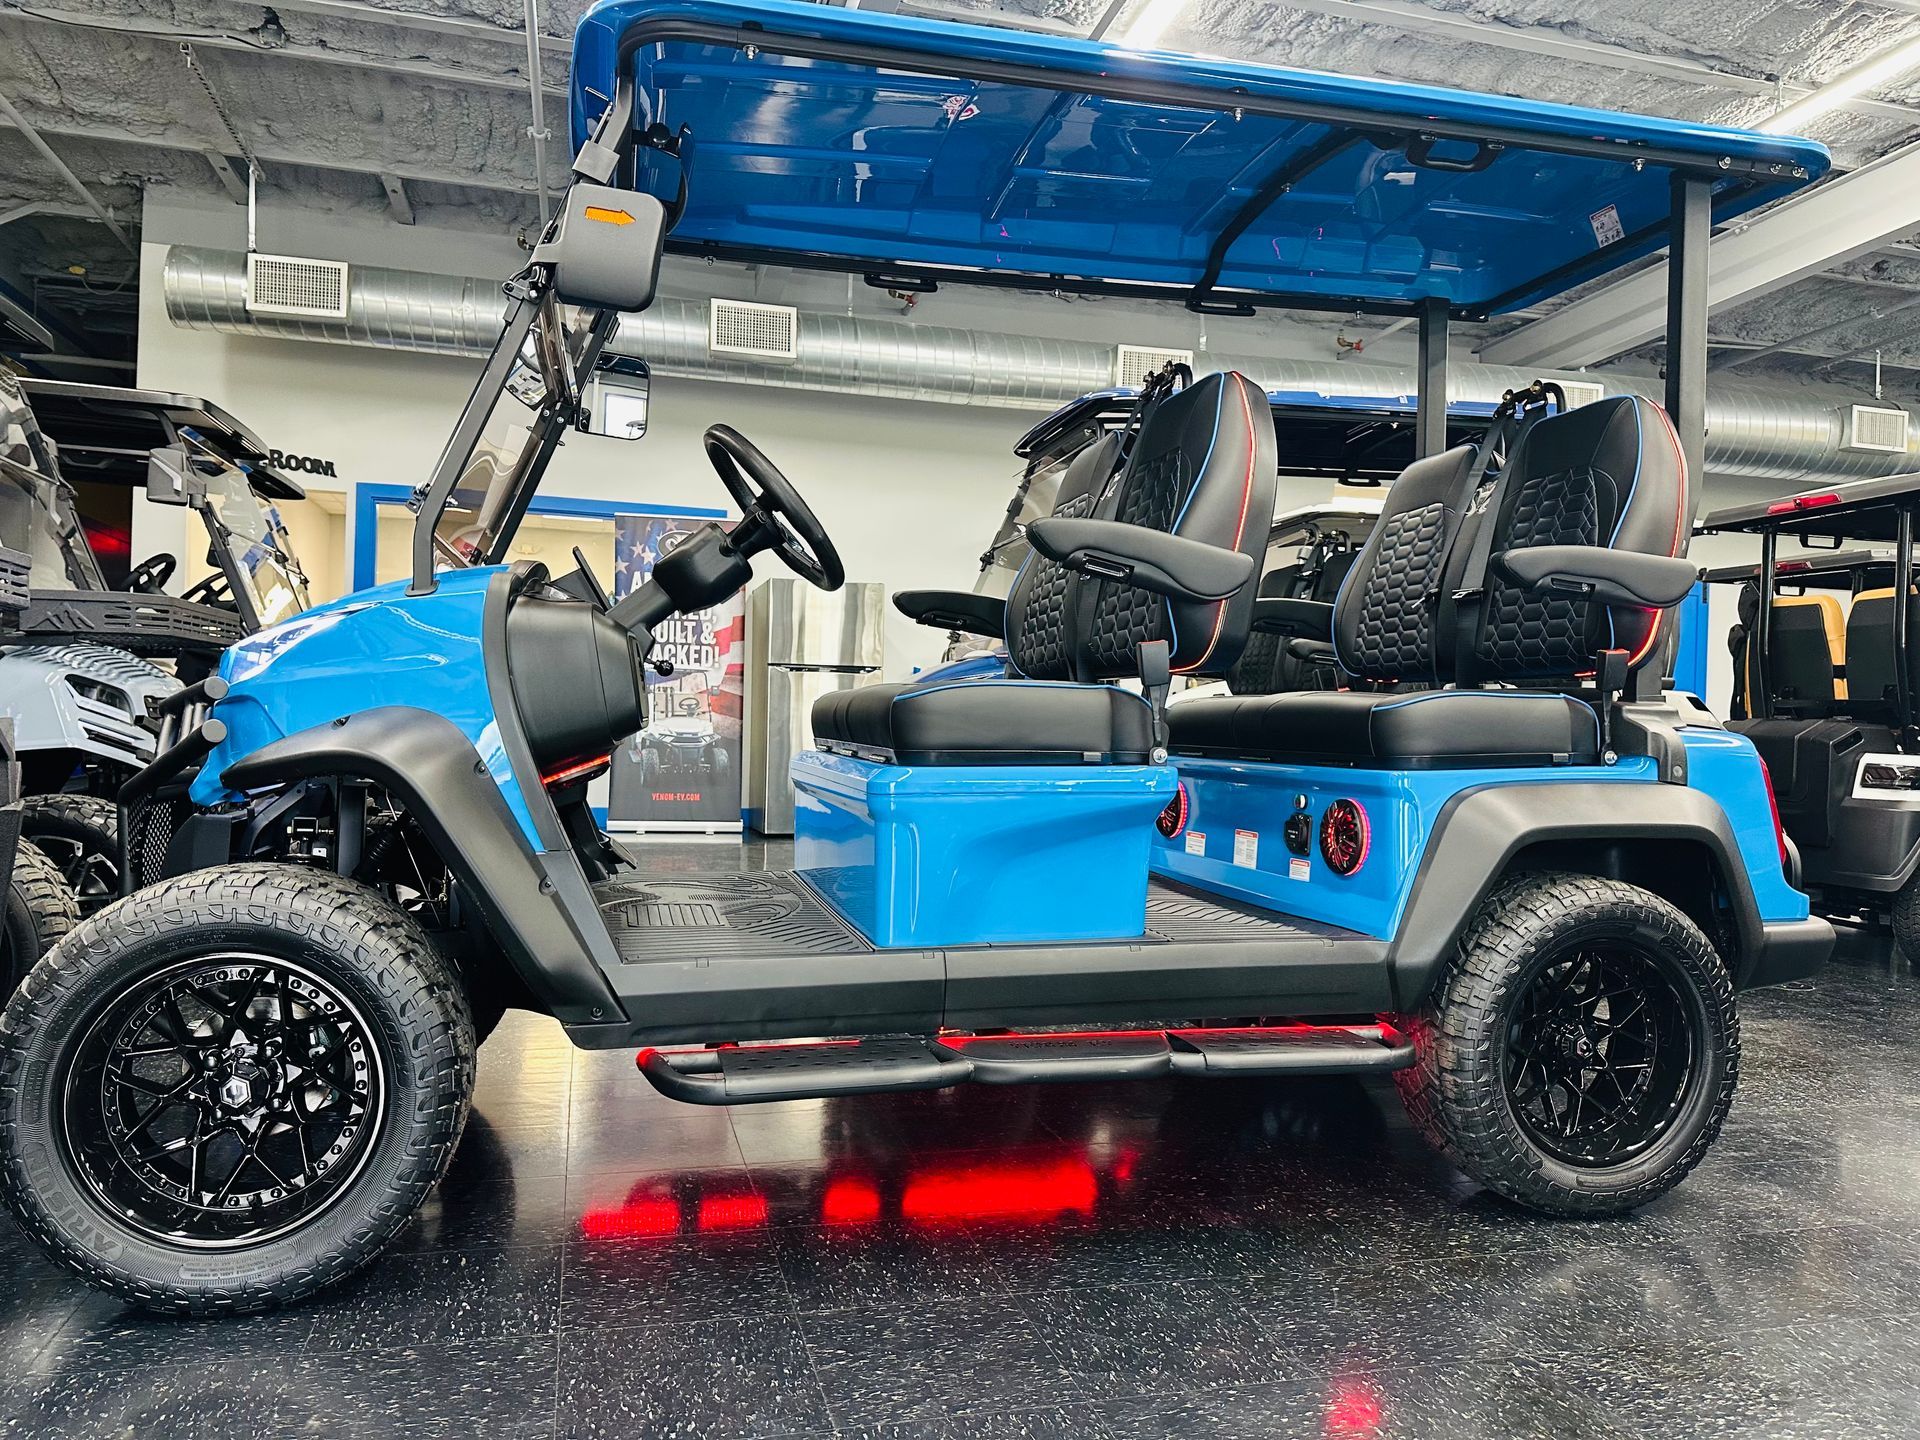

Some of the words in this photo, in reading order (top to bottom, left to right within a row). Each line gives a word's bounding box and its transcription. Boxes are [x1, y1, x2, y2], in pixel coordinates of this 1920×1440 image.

[269, 449, 338, 478] ROOM
[650, 620, 697, 644] UILT
[700, 621, 717, 645] &
[647, 643, 720, 668] ACKED!
[651, 792, 701, 801] VENOM-EV.COM
[25, 1147, 120, 1253] ARISUN
